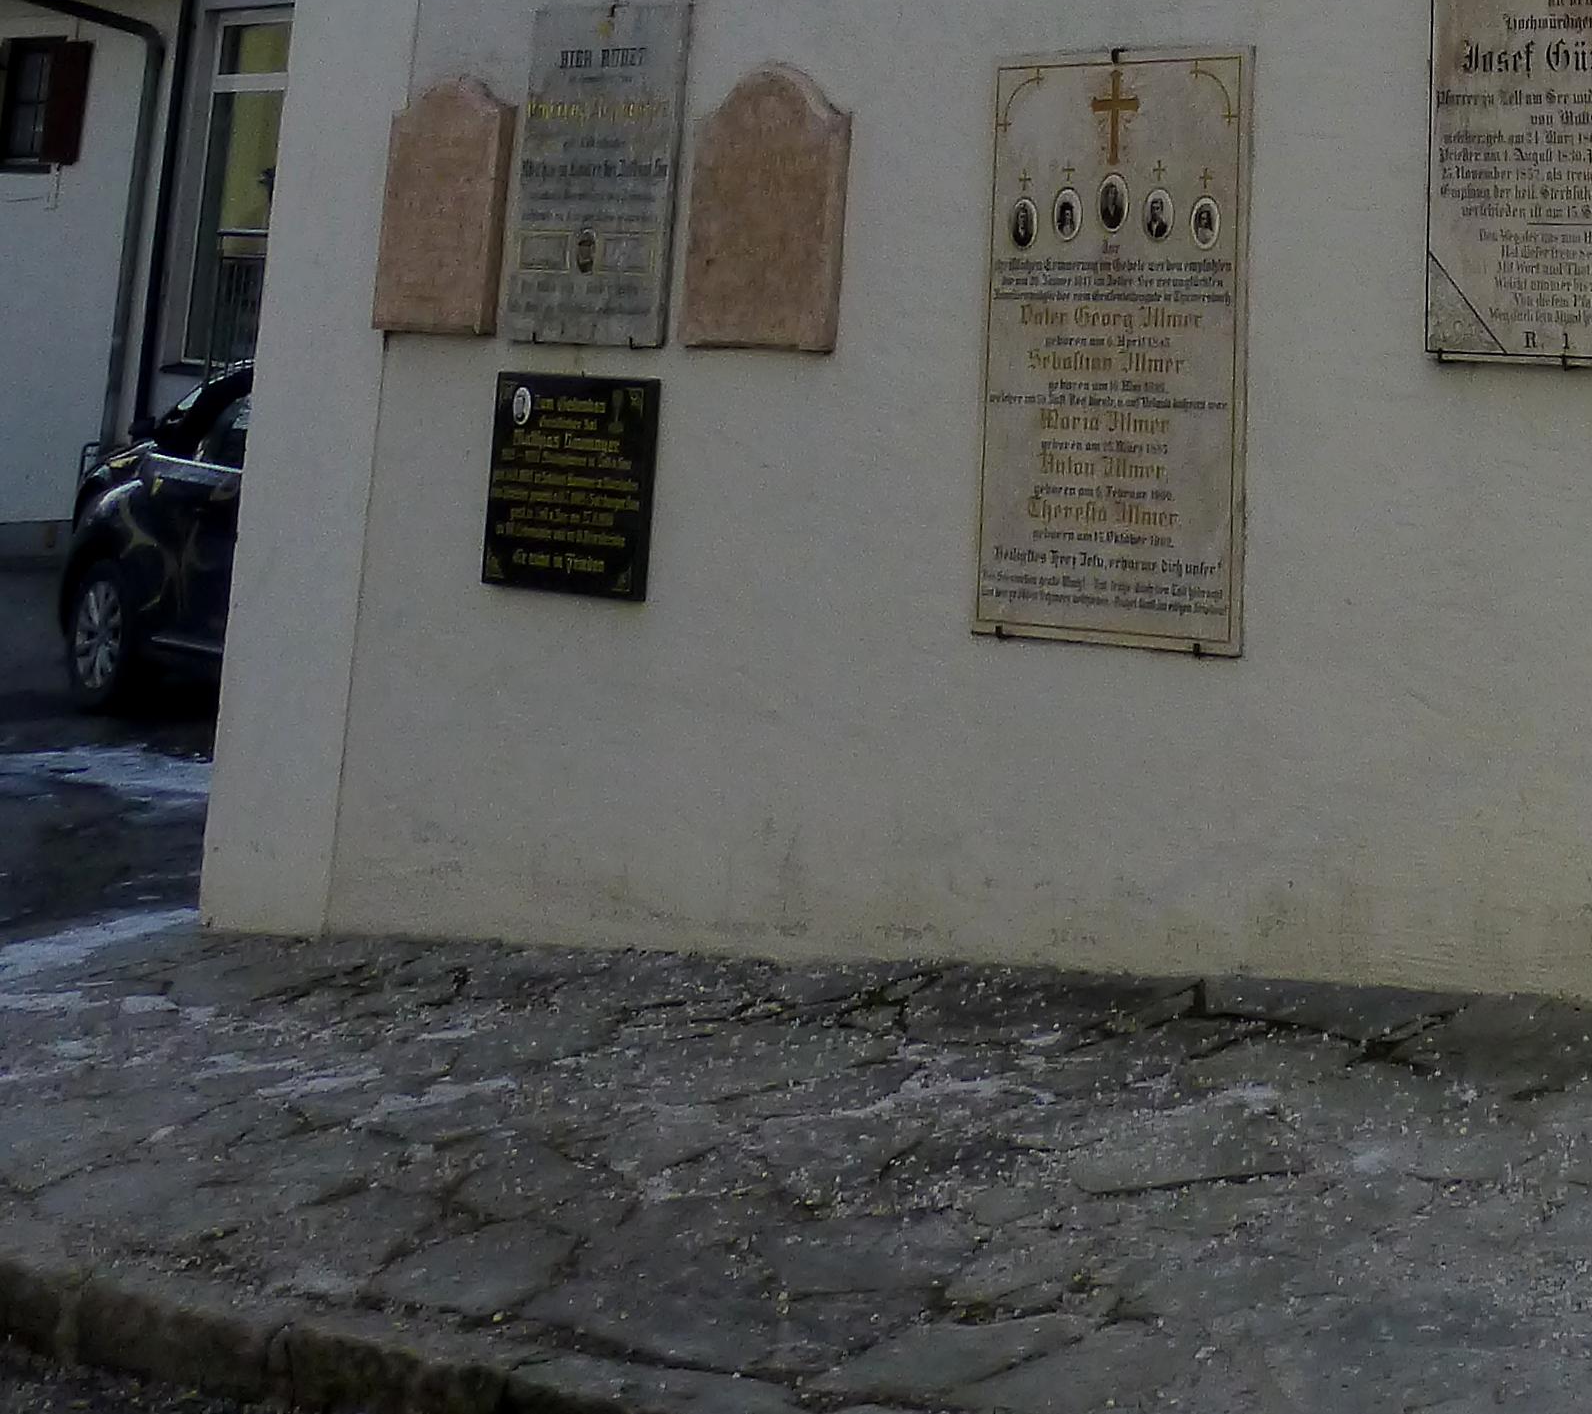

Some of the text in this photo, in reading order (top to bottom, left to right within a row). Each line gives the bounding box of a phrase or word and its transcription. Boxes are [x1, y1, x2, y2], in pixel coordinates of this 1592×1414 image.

[1462, 38, 1535, 78] Josef
[1525, 93, 1543, 105] am
[1546, 88, 1569, 105] See
[1530, 114, 1553, 127] von
[1513, 147, 1553, 166] August
[1455, 165, 1513, 181] November
[1493, 183, 1512, 200] der
[1018, 304, 1066, 327] Vater
[1074, 303, 1134, 333] Georg
[1045, 334, 1087, 348] geboren
[1089, 336, 1105, 347] am
[1026, 347, 1113, 372] Sebastian
[1048, 378, 1089, 393] geboren
[1039, 407, 1099, 432] Maria
[1040, 437, 1083, 452] geboren
[1085, 440, 1101, 452] am
[1037, 451, 1096, 477] Anton
[1033, 482, 1076, 500] geboren
[1078, 485, 1094, 498] am
[1105, 484, 1147, 500] Februar
[1026, 496, 1108, 524] Theresia
[1032, 527, 1075, 542] geboren
[1076, 530, 1093, 542] am
